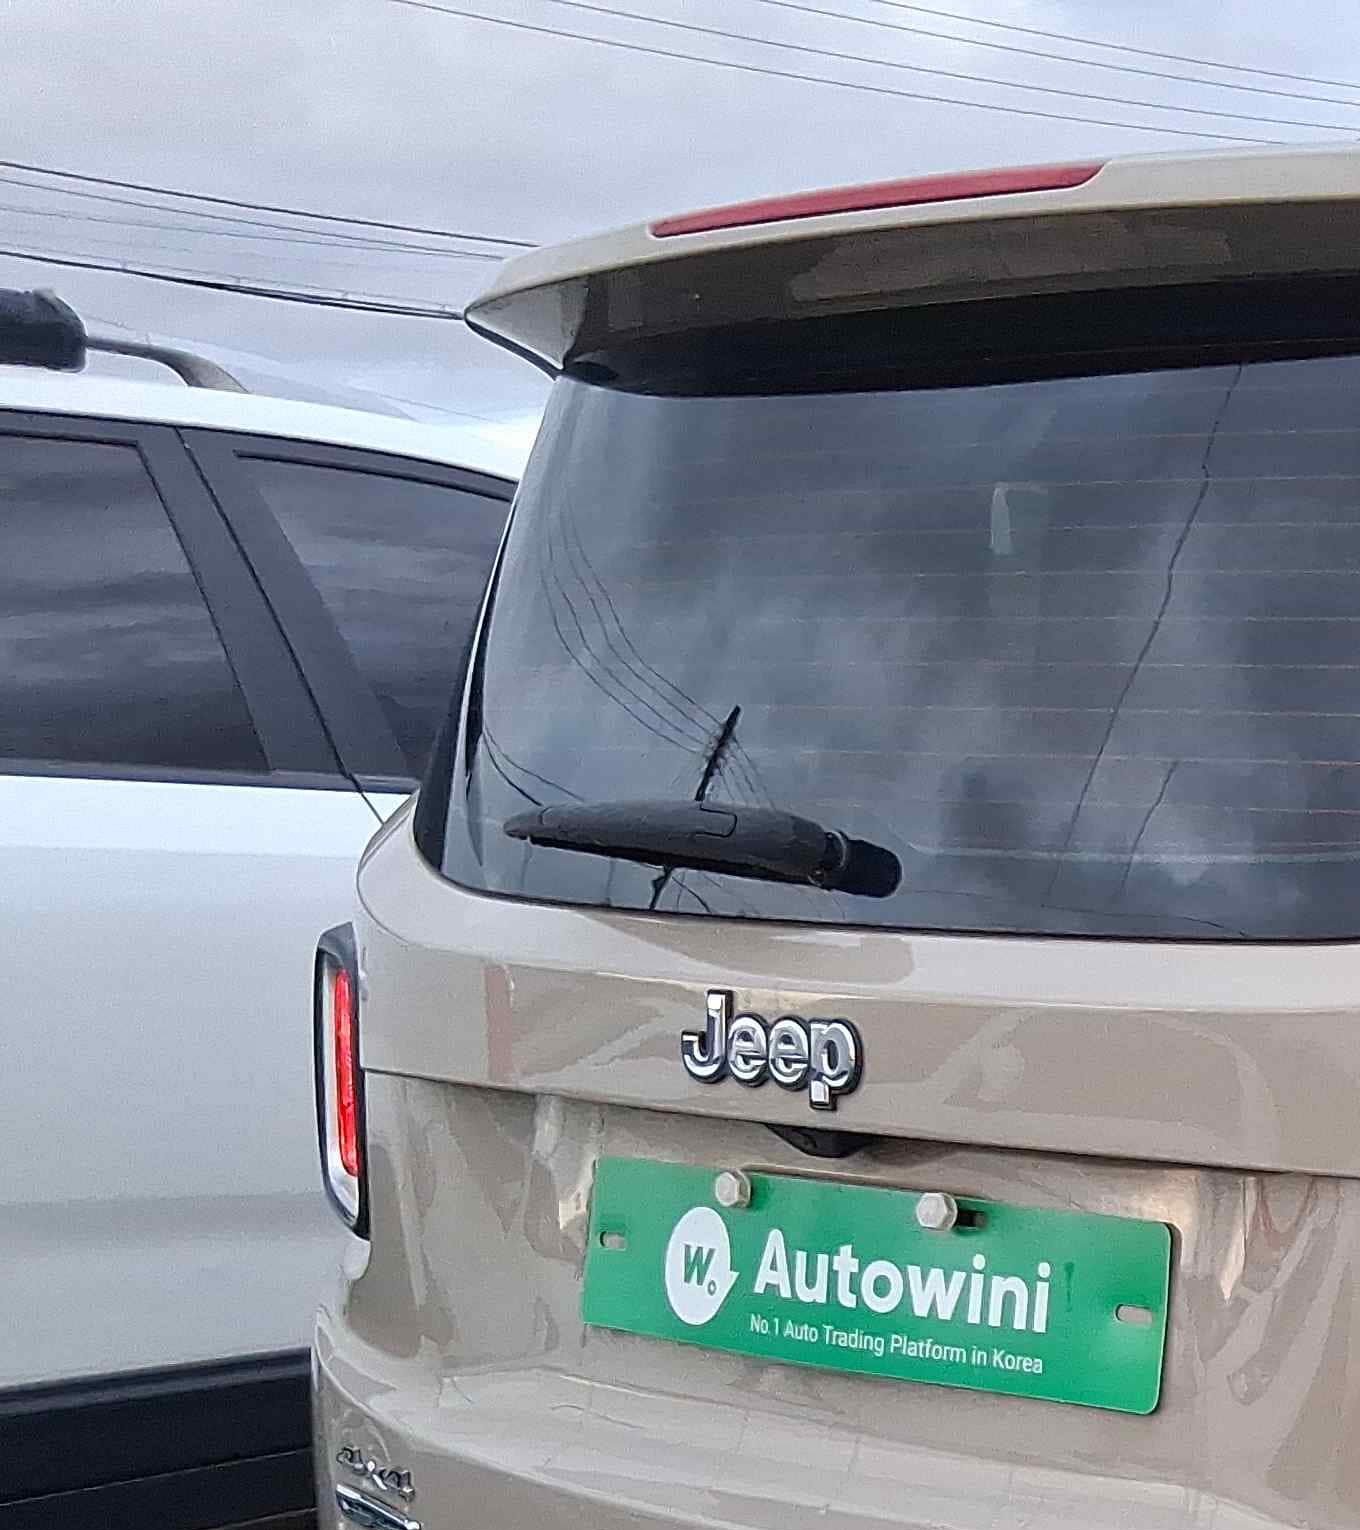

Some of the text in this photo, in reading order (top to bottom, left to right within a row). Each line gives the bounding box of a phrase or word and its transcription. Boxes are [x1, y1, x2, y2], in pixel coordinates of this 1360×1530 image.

[681, 988, 864, 1111] Jeep
[753, 1228, 1051, 1333] Autowini
[784, 1321, 818, 1343] Auto
[823, 1325, 885, 1356] Trading
[890, 1335, 967, 1363] Platform
[971, 1346, 987, 1366] in
[992, 1348, 1043, 1374] Korea
